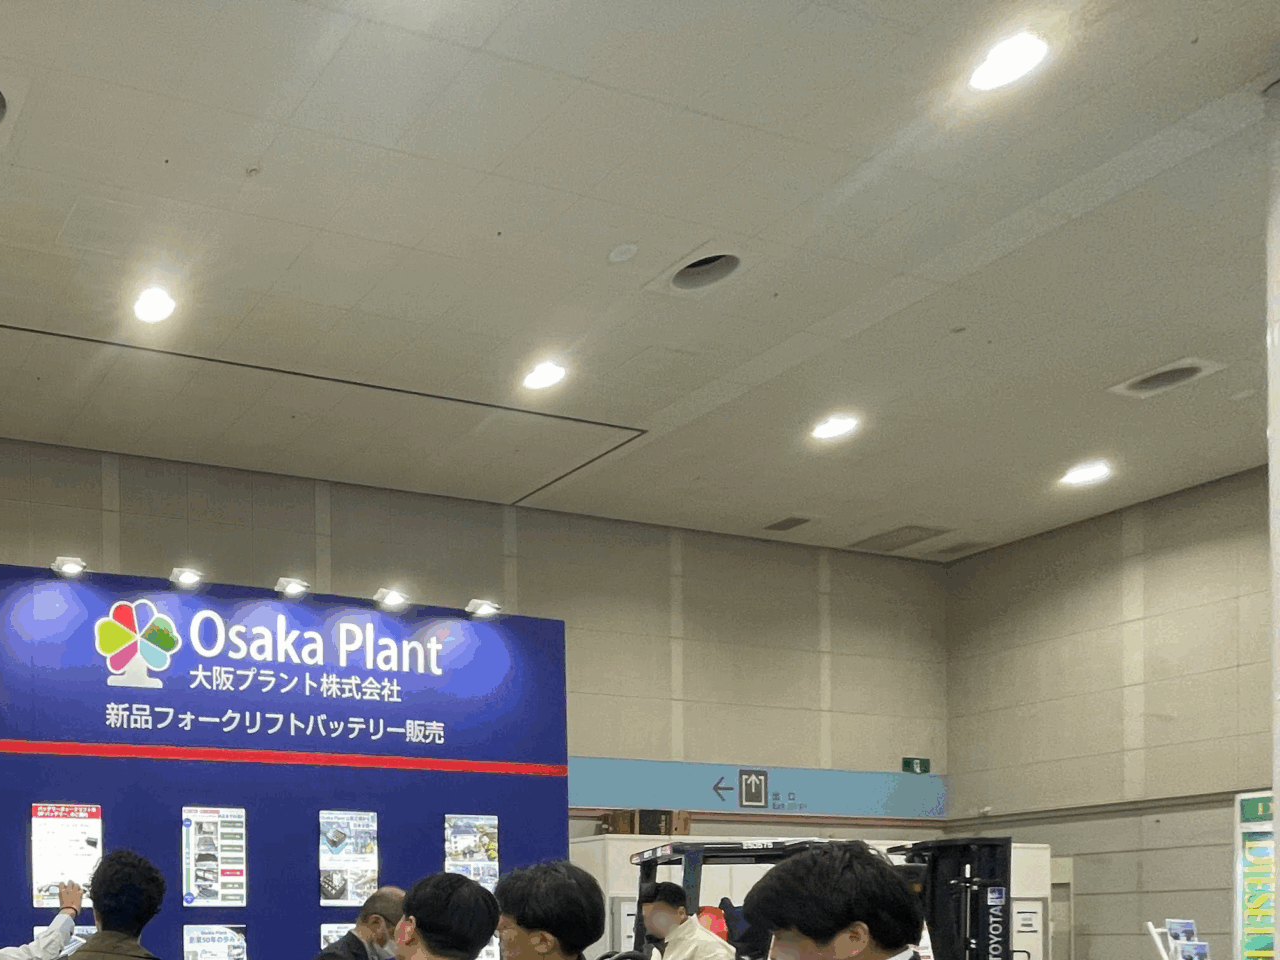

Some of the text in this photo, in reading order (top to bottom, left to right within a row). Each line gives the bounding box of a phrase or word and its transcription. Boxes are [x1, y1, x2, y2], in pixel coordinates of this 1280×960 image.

[190, 608, 443, 676] Osaka Plant
[190, 666, 402, 703] 大阪プラント株式会社
[105, 703, 445, 745] 新品フォークリフトバッテリー販売
